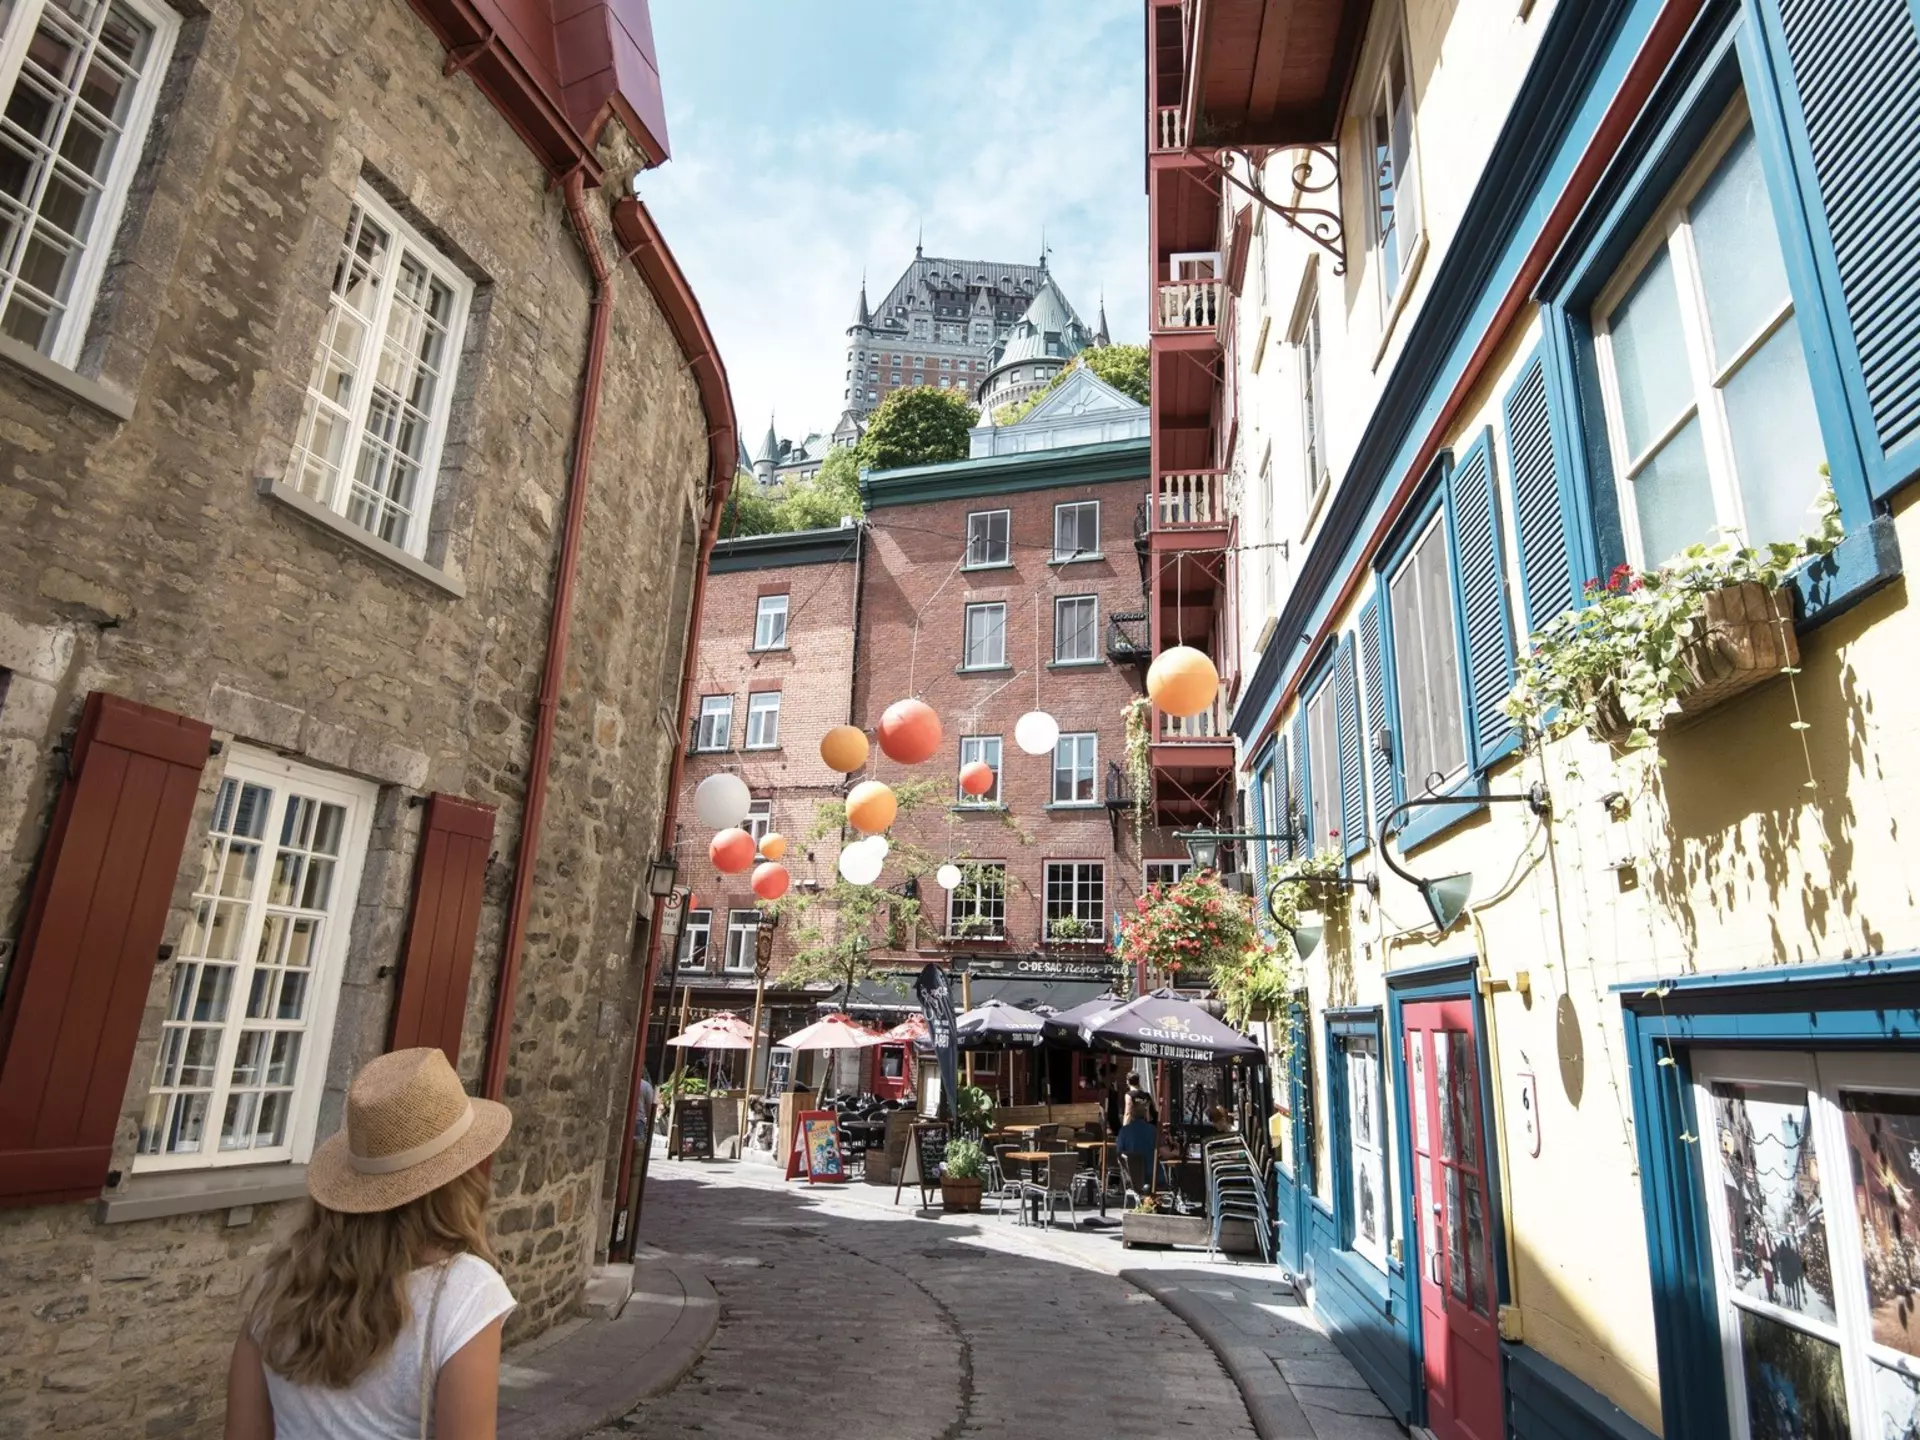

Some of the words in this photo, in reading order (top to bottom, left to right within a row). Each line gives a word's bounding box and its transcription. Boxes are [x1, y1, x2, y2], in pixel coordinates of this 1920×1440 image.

[1138, 1027, 1215, 1044] GRIFFON
[1140, 1042, 1158, 1054] SUIS
[1159, 1044, 1174, 1056] TON
[1176, 1047, 1214, 1061] INSTINCT
[1523, 1087, 1530, 1110] 6
